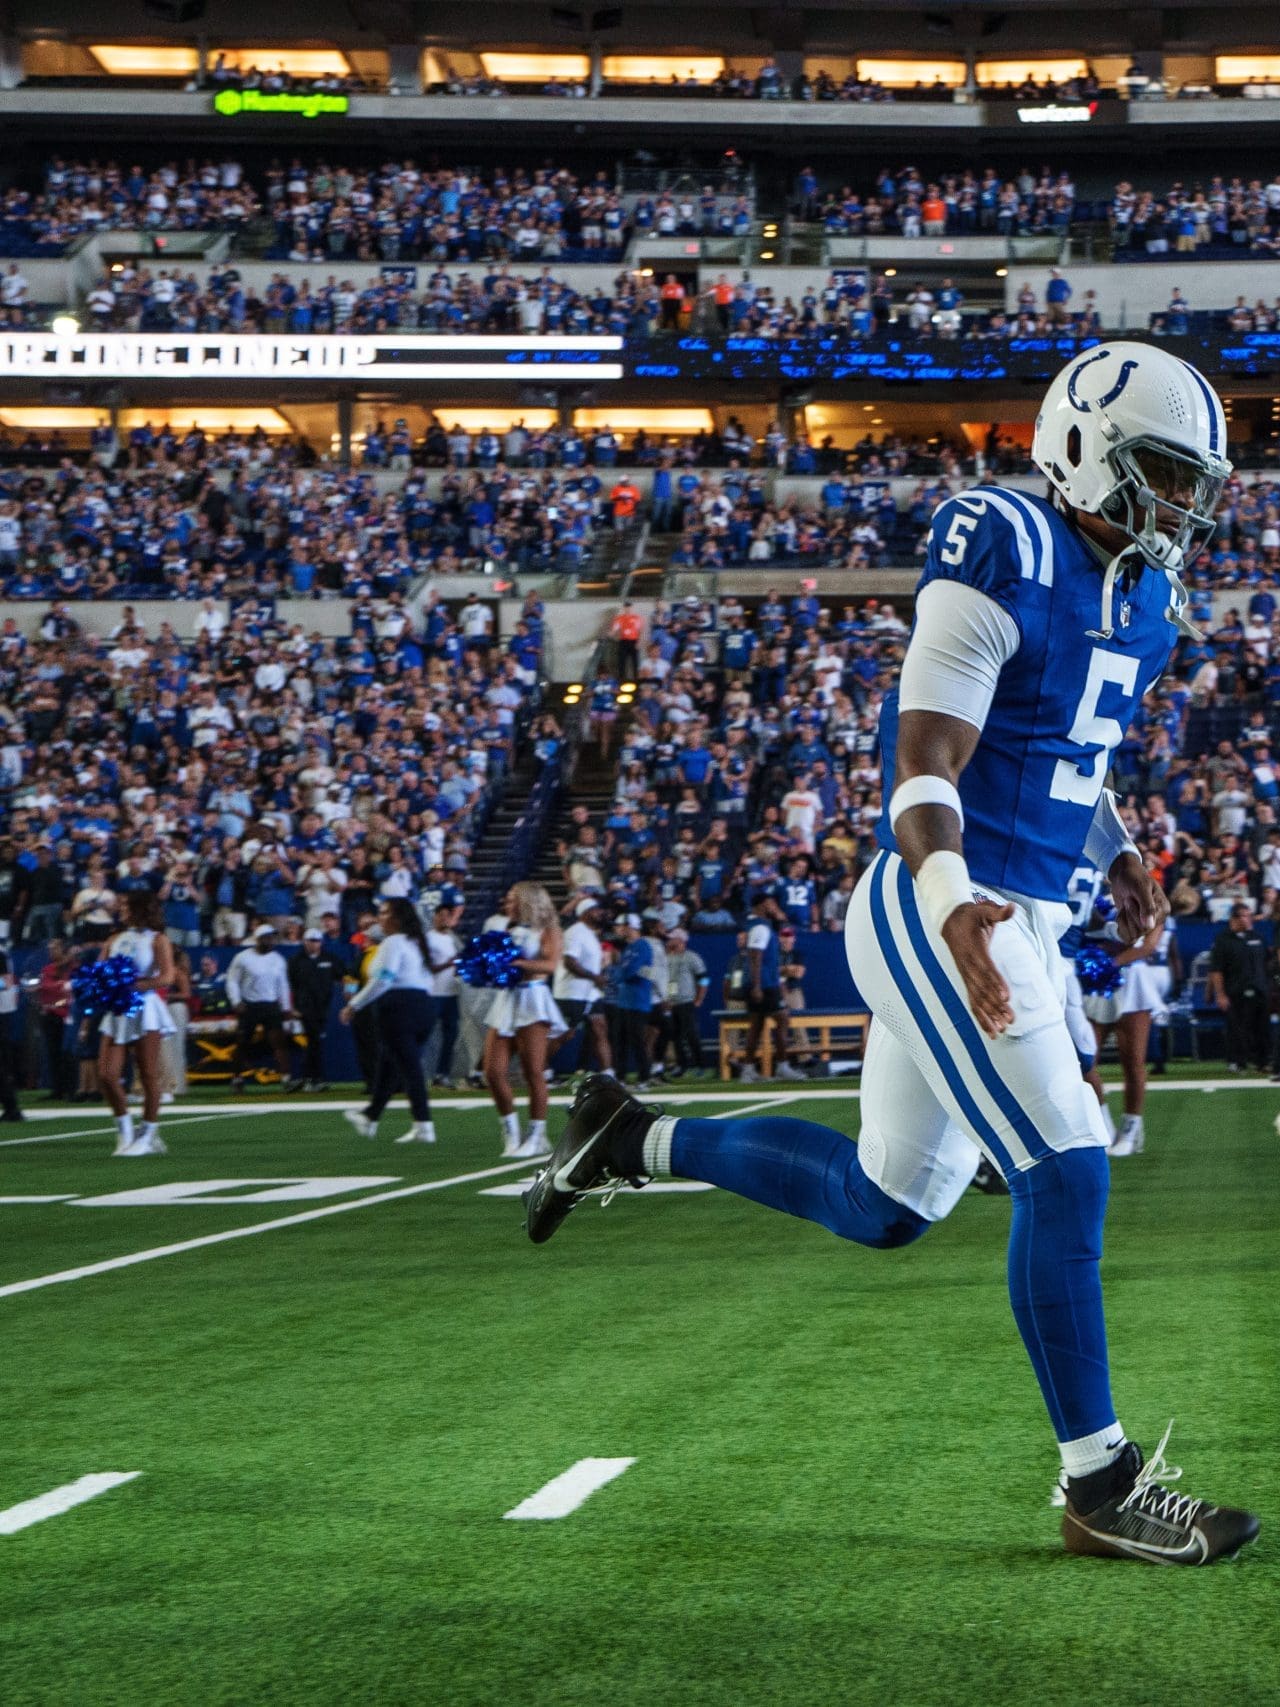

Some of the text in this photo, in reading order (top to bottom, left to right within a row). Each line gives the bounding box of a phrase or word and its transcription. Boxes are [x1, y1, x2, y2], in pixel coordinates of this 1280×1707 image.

[941, 512, 979, 566] 5
[1050, 647, 1141, 807] 5
[786, 885, 809, 906] 12
